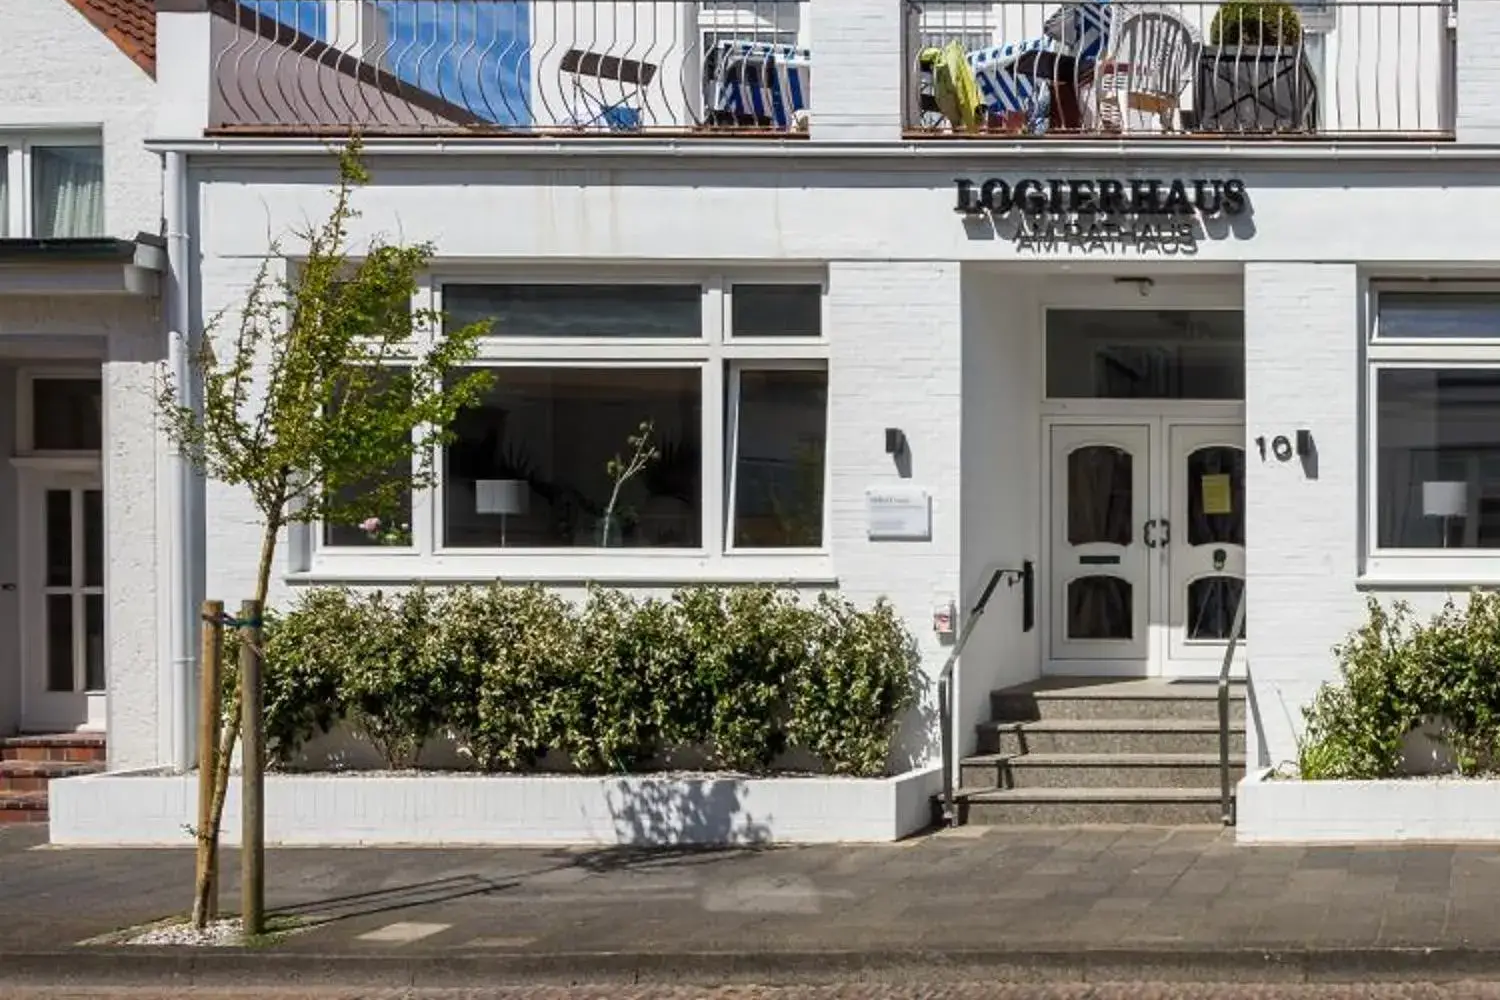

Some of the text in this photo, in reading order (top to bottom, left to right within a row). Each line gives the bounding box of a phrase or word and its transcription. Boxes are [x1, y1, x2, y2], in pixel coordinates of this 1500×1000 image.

[953, 178, 1247, 214] LOGIERHAUS
[1013, 222, 1195, 247] AM RATHAUS
[1255, 435, 1292, 463] 10
